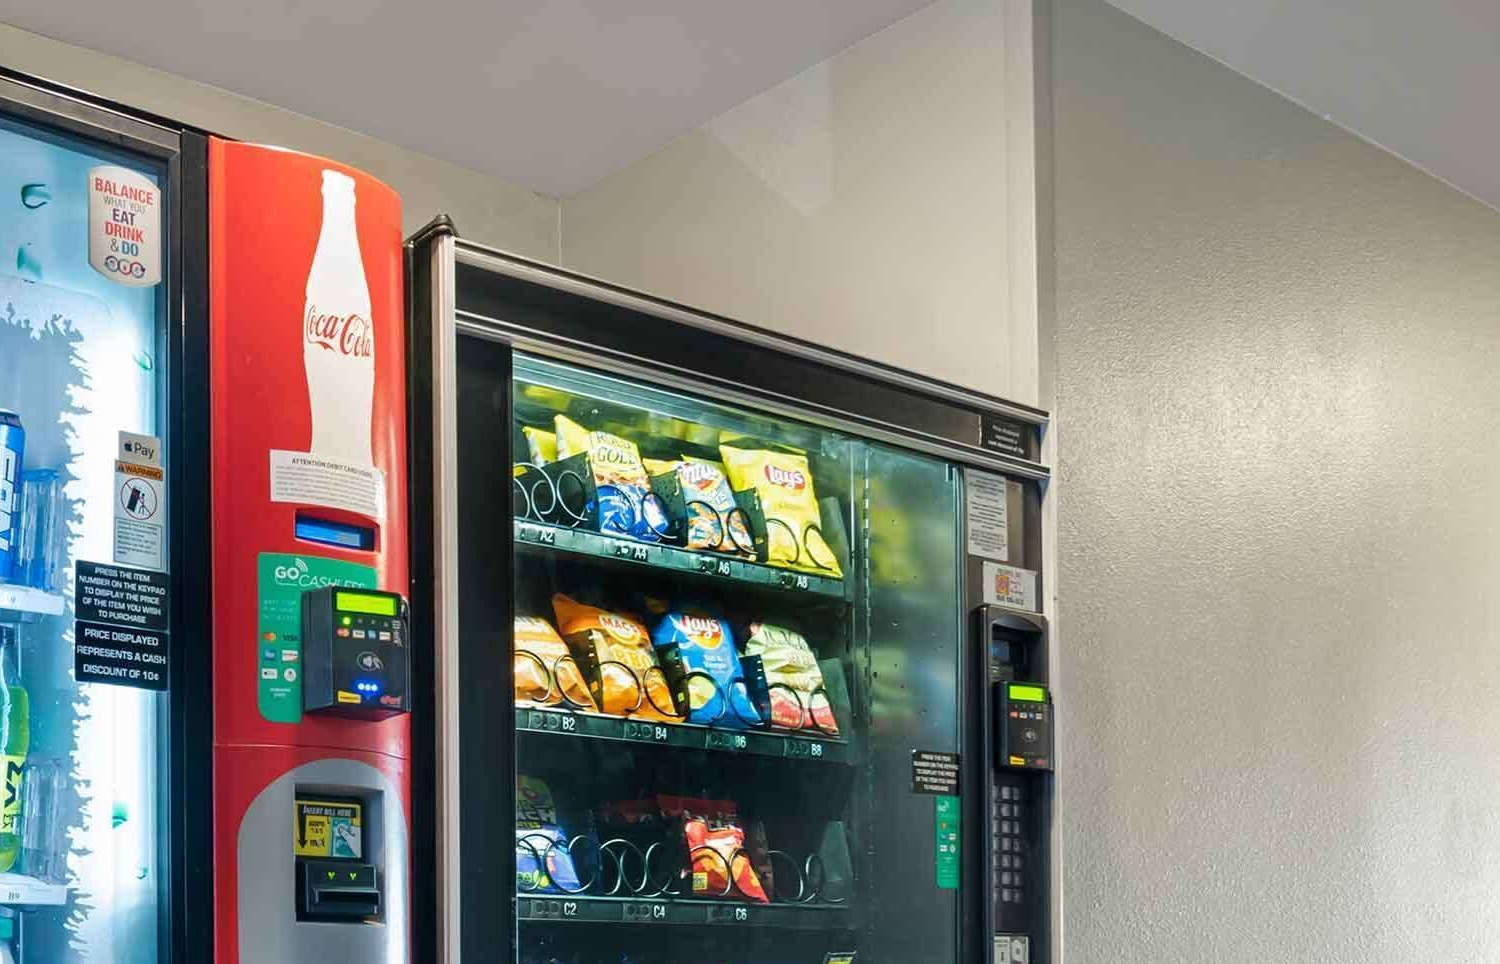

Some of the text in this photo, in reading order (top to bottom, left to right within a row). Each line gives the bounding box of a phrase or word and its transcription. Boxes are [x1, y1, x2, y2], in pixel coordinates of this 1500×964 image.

[95, 177, 153, 206] BALANCE
[103, 195, 146, 214] WHAT YOU
[113, 208, 136, 226] EAT
[104, 221, 144, 244] DRINK
[110, 238, 139, 257] & DO
[307, 303, 371, 358] Coca-Cola
[134, 442, 155, 459] Pay
[125, 463, 162, 480] WARNING
[292, 457, 326, 469] ATTENTION
[540, 530, 554, 543] A2
[634, 548, 647, 561] A4
[718, 563, 730, 576] A6
[95, 567, 150, 583] PRESS THE ITEM
[274, 566, 300, 580] GO
[79, 576, 166, 595] NUMBER ON THE KEYPAD
[84, 586, 160, 606] TO DISPLAY THE PRICE
[82, 597, 162, 616] OF THE ITEM YOU WISH
[98, 609, 146, 624] TO PURCHASE
[85, 628, 159, 646] PRICE DISPLAYED
[77, 645, 166, 665] REPRESENTS A CASH
[83, 663, 128, 677] DISCOUNT
[129, 670, 140, 679] OF
[562, 717, 576, 731] B2
[655, 726, 668, 740] B4
[564, 902, 748, 921] C2 C4 C6
